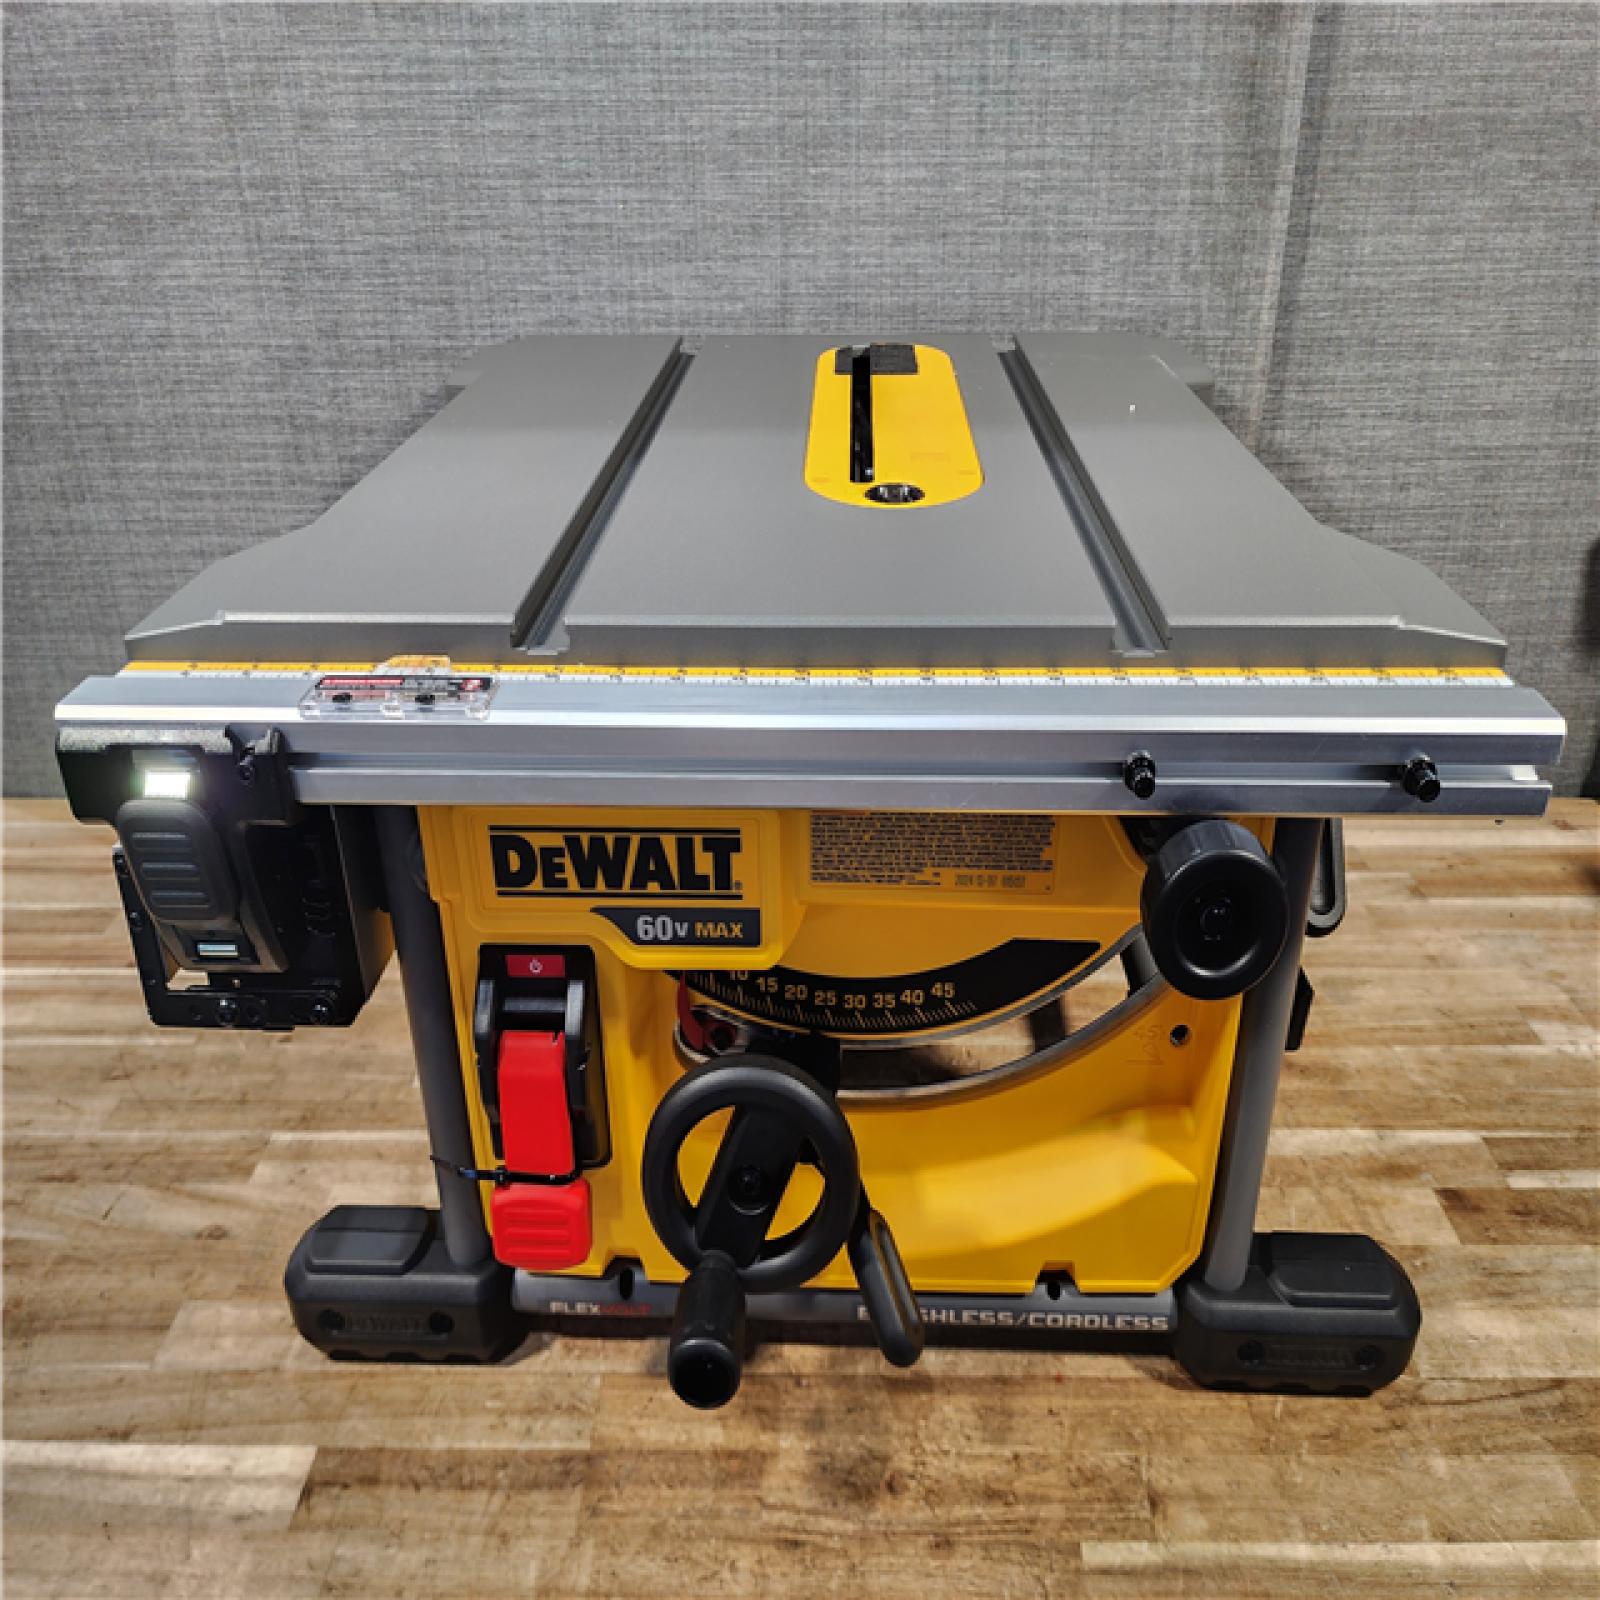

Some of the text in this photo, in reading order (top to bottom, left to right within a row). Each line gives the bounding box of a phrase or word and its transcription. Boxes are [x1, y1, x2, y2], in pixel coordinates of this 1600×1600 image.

[489, 834, 742, 891] DEWALT
[694, 921, 744, 939] MAX
[755, 976, 779, 993] 15
[784, 984, 808, 1001] 20
[814, 989, 837, 1006] 25
[844, 993, 866, 1009] 30
[873, 992, 896, 1009] 35
[900, 988, 926, 1005] 40
[930, 981, 956, 999] 45
